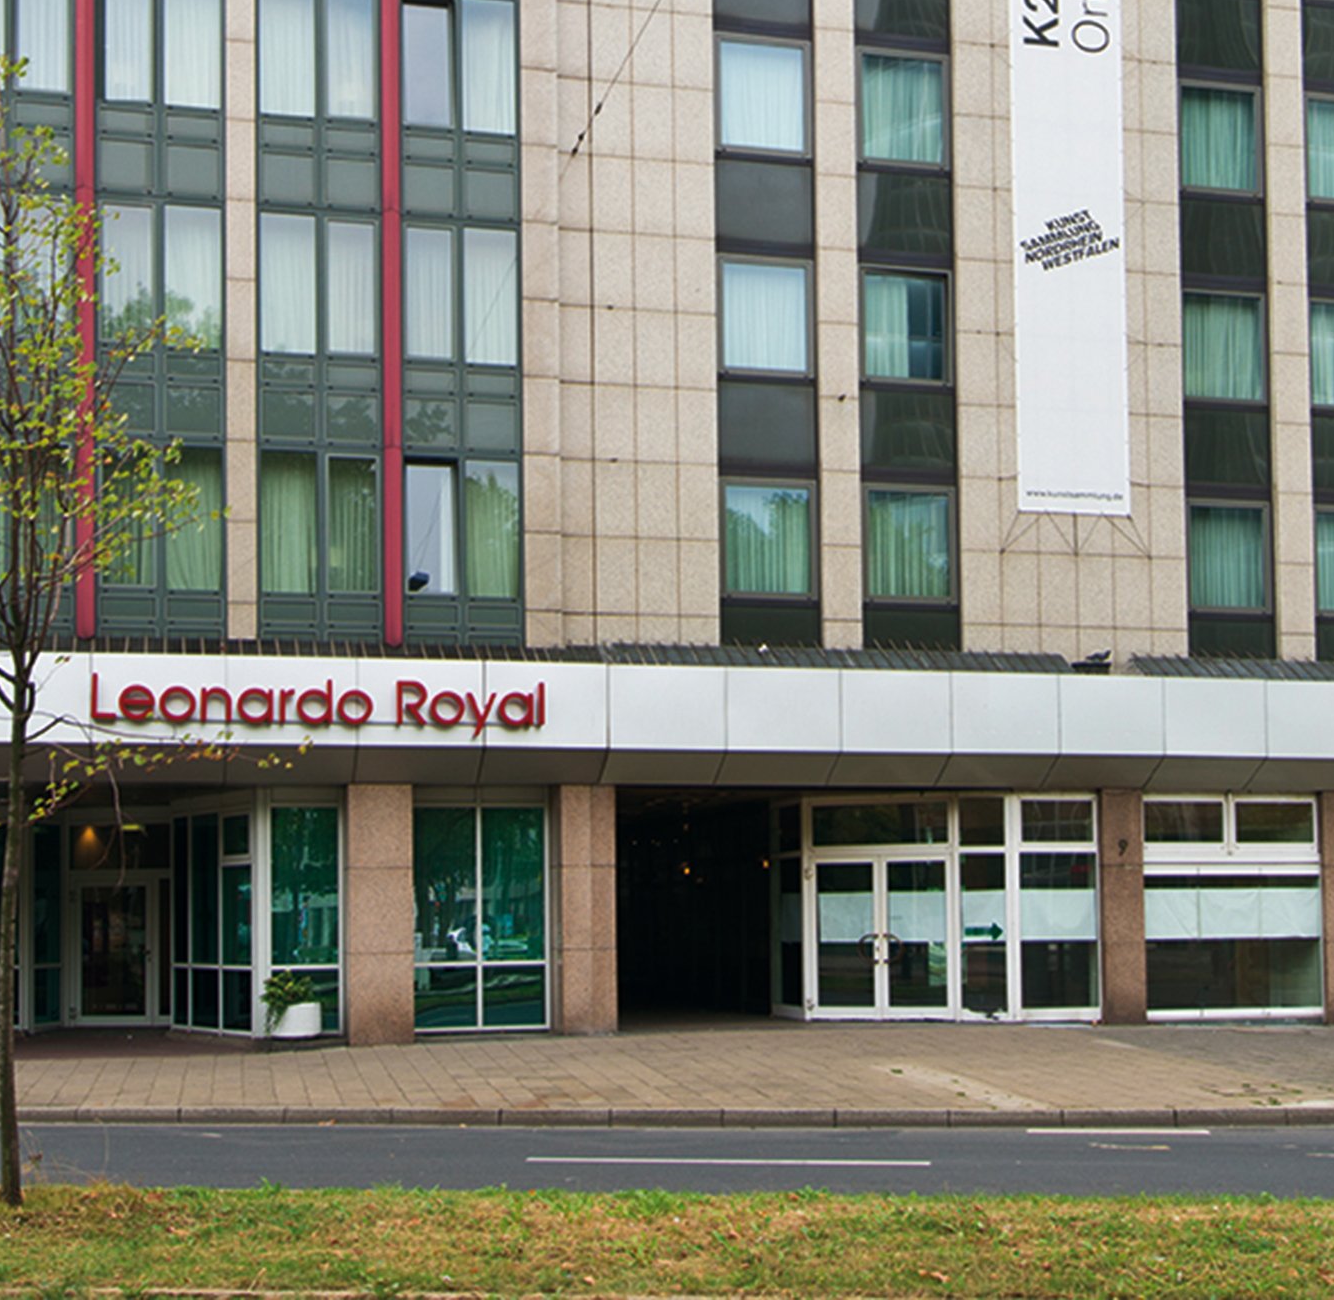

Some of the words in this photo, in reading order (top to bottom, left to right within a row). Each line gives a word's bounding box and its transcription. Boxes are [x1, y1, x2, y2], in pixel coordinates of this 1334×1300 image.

[1019, 220, 1101, 252] SAMMLUNG
[1044, 209, 1092, 231] KUNST
[1024, 231, 1103, 264] NORDRHEIN
[1041, 237, 1120, 272] WESTFALEN
[90, 672, 374, 725] Leonardo
[395, 680, 546, 741] Royal
[1117, 838, 1129, 857] 9
